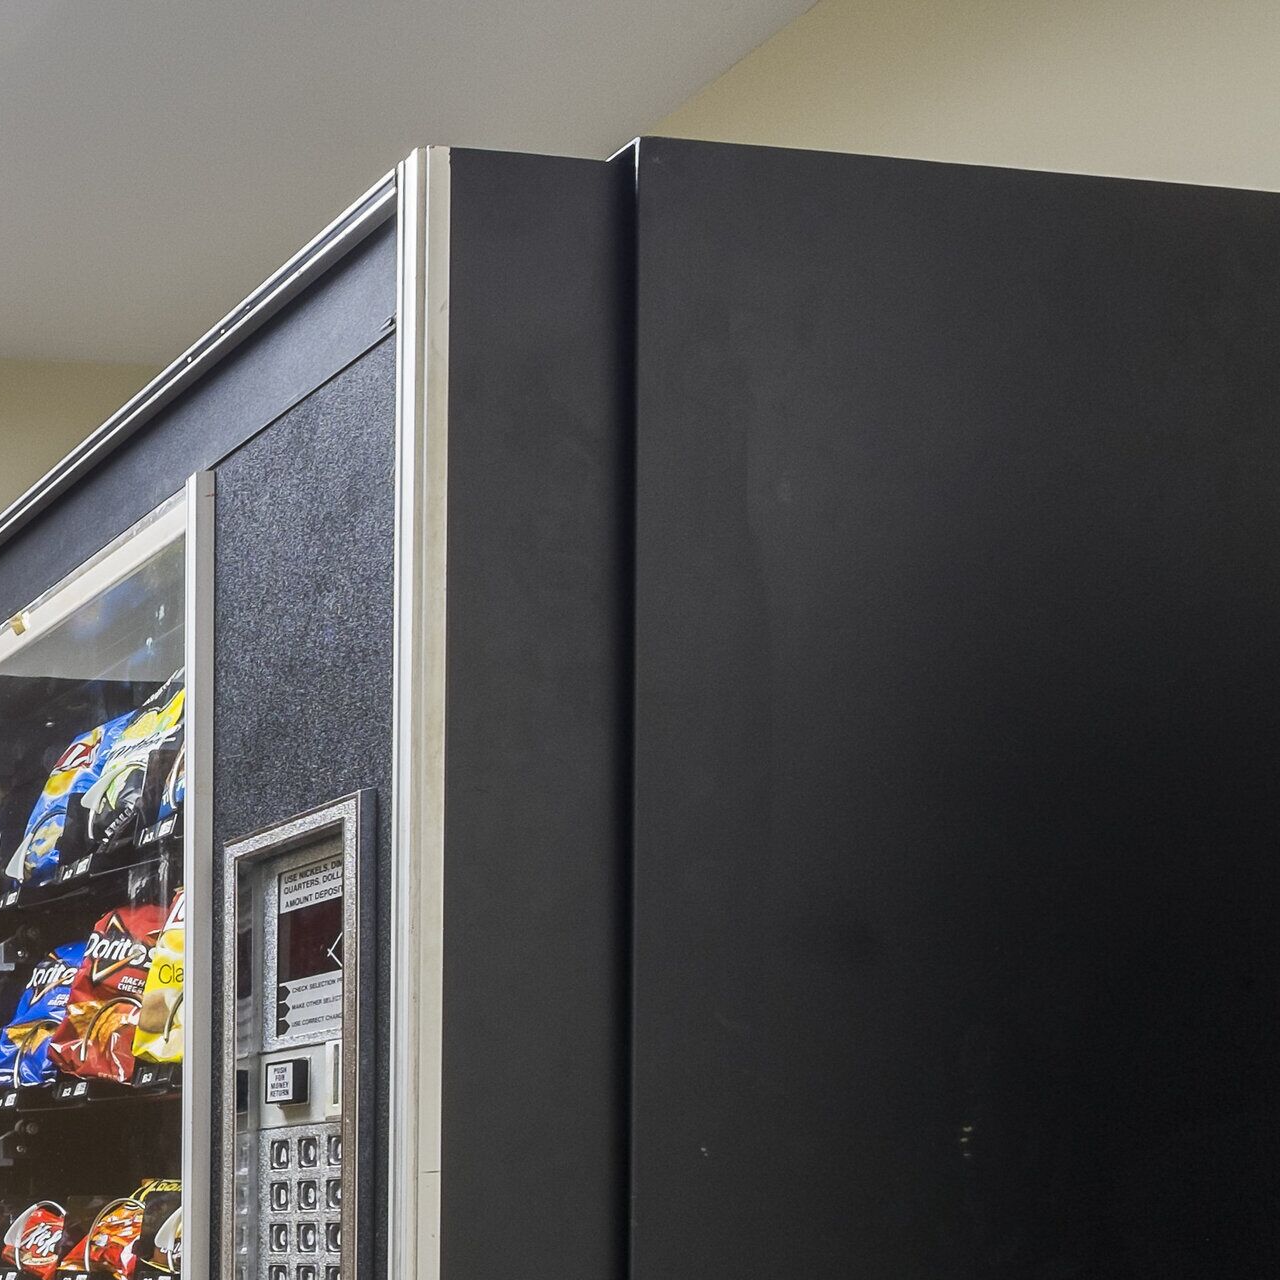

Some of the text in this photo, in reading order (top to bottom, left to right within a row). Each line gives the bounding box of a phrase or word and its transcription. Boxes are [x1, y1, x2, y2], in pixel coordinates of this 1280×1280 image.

[284, 874, 297, 884] USE
[285, 893, 313, 908] AMOUNT
[158, 964, 183, 985] Cla
[121, 975, 146, 987] NACH
[309, 979, 336, 989] SELECTION
[306, 999, 322, 1008] OTHER
[323, 994, 343, 1004] SELECT
[273, 1066, 287, 1075] PUSH
[270, 1081, 289, 1089] MONEY
[270, 1089, 289, 1097] RETURN
